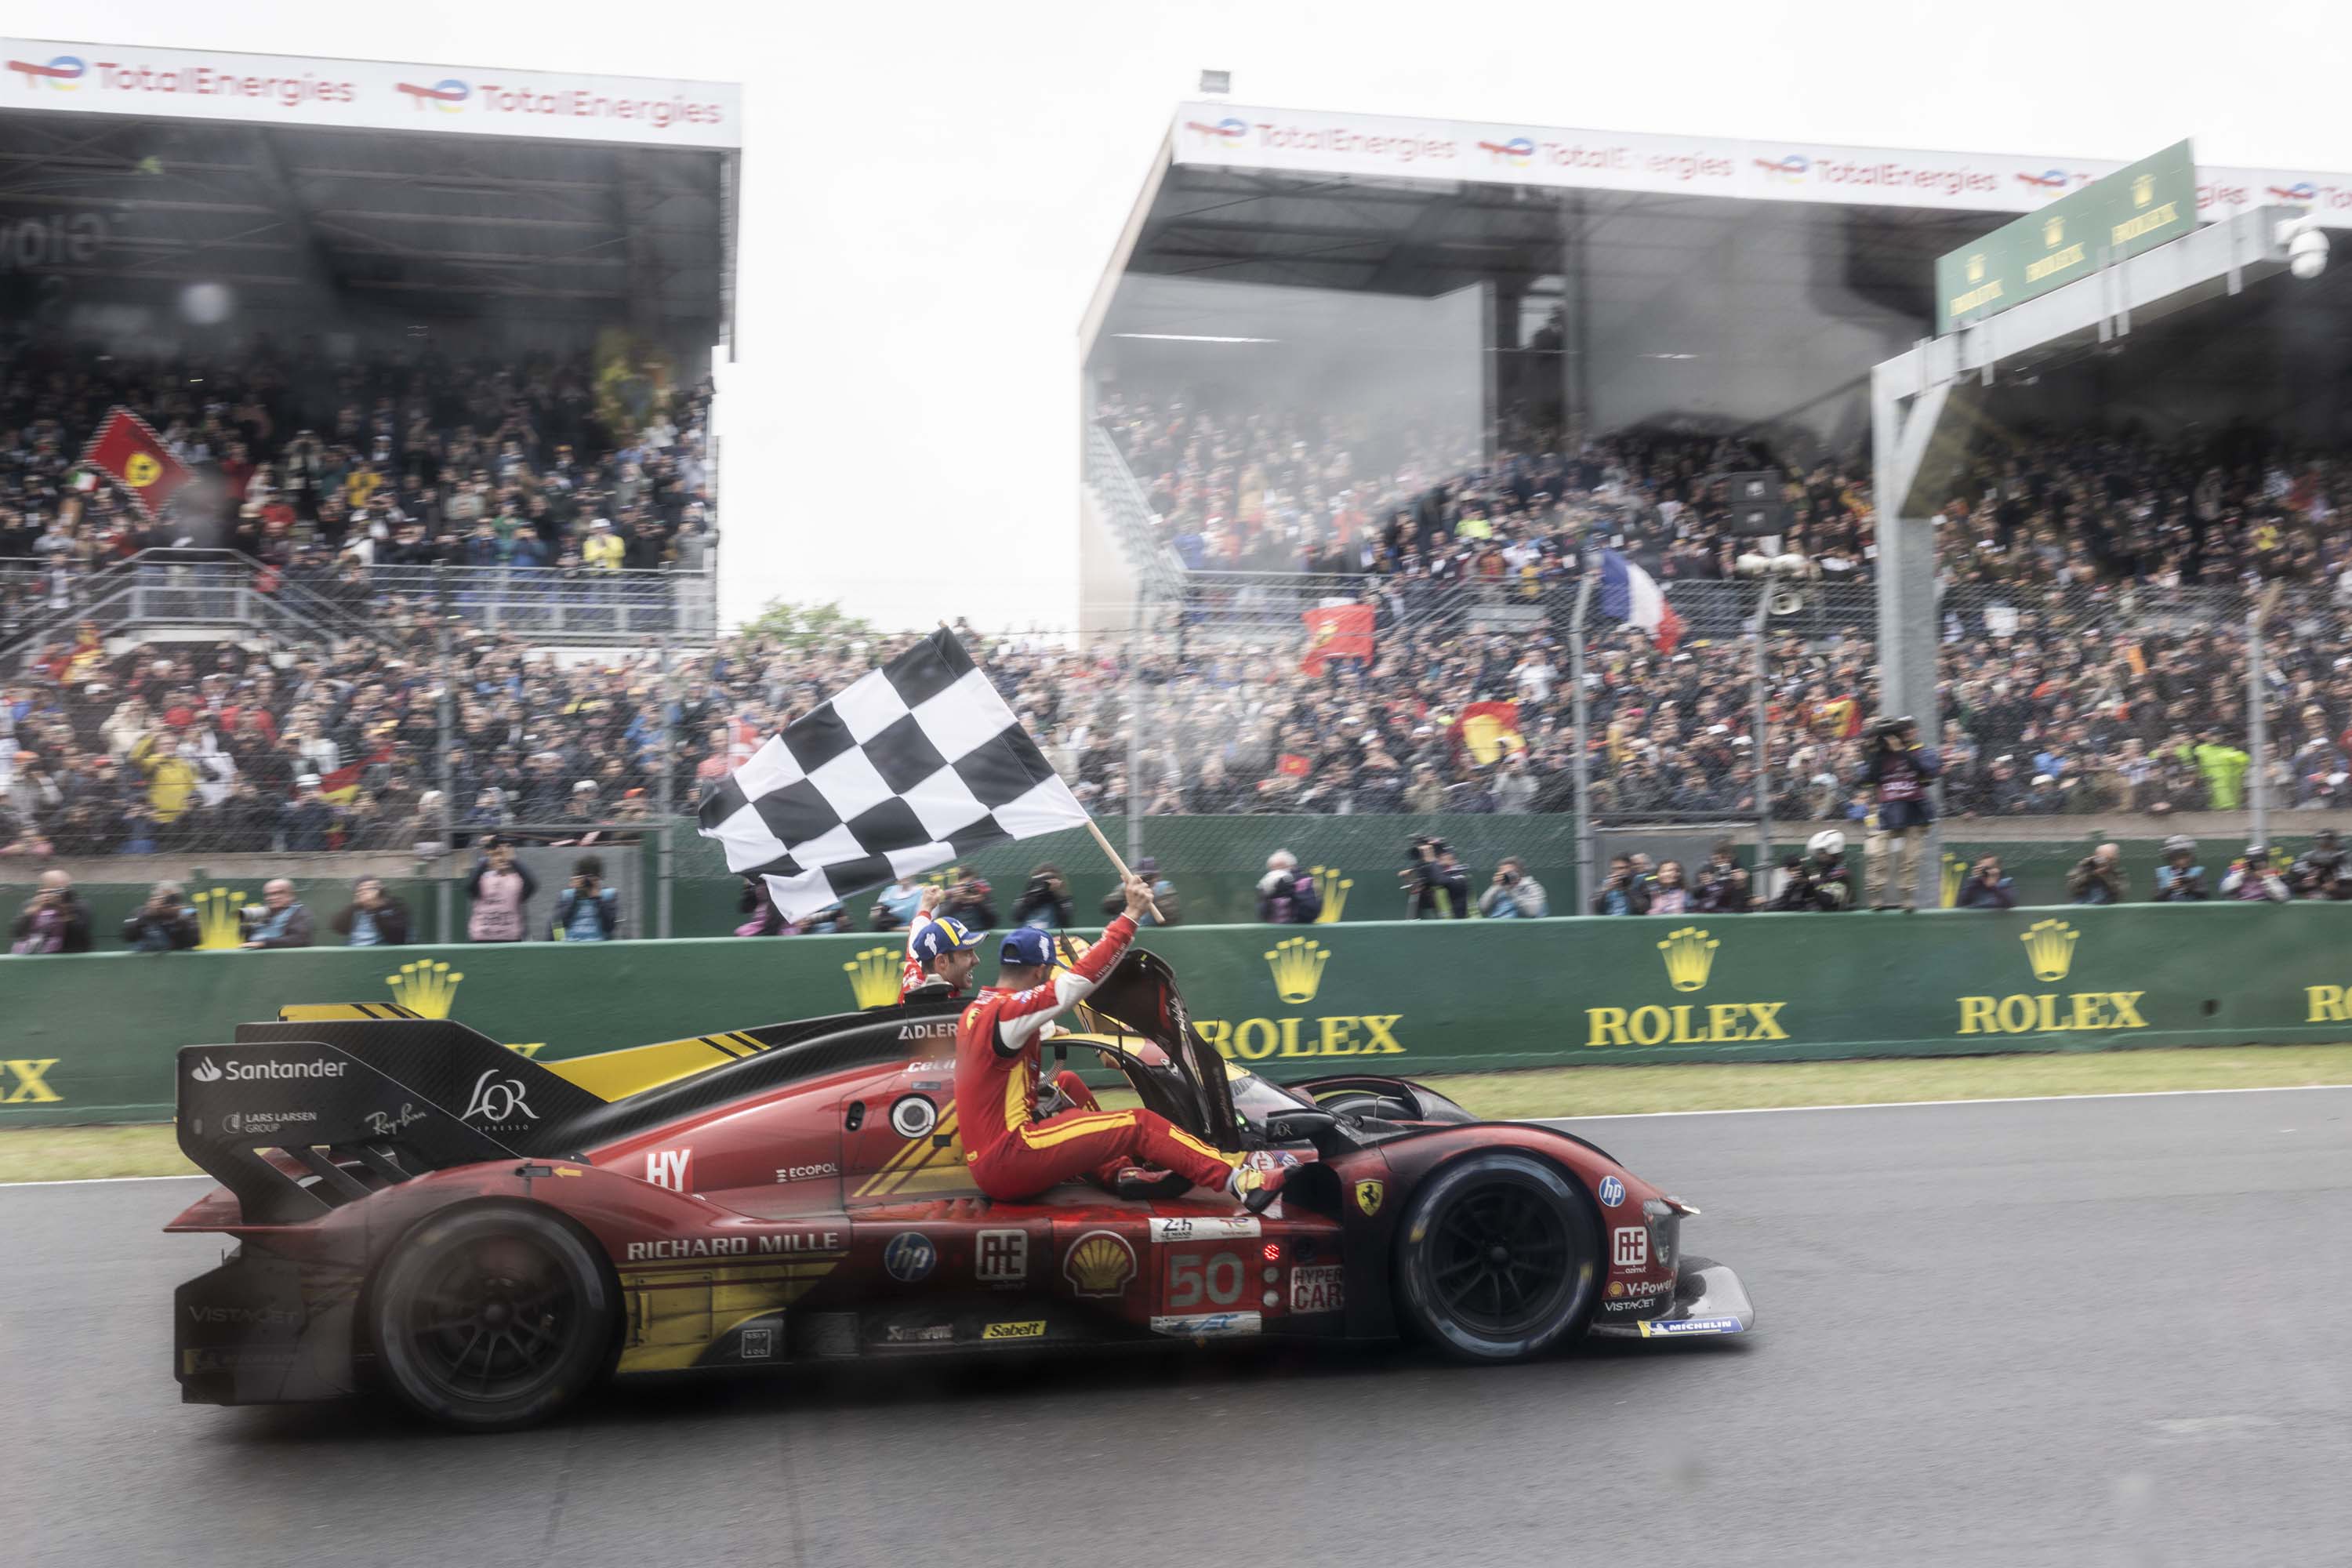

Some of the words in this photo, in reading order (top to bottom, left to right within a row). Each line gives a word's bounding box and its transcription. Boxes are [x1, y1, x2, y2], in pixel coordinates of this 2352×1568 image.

[95, 61, 357, 107] TotalEnergies
[479, 85, 722, 128] TotalEnergies
[1254, 124, 1457, 162] TotalEnergies
[1814, 159, 1998, 195] TotalEnergies
[1957, 990, 2149, 1034] ROLEX
[2304, 985, 2352, 1022] R
[1192, 1014, 1408, 1060] ROLEX
[1584, 1002, 1791, 1047] ROLEX
[225, 1058, 348, 1081] Santander
[245, 1112, 273, 1123] LARS
[275, 1112, 318, 1122] LARSEN
[245, 1123, 281, 1134] GROUP
[647, 1149, 691, 1192] HY
[789, 1163, 840, 1178] ECOPOL
[1603, 1176, 1621, 1207] hp
[628, 1237, 749, 1261] RICHARD
[759, 1232, 839, 1253] MILLE
[892, 1232, 930, 1281] hp
[1170, 1253, 1245, 1308] 50
[1295, 1268, 1343, 1285] HYPER
[1626, 1279, 1672, 1296] V-Power
[1294, 1284, 1343, 1309] CAR
[990, 1323, 1041, 1338] Sabelt
[1669, 1320, 1732, 1331] MICHELIN
